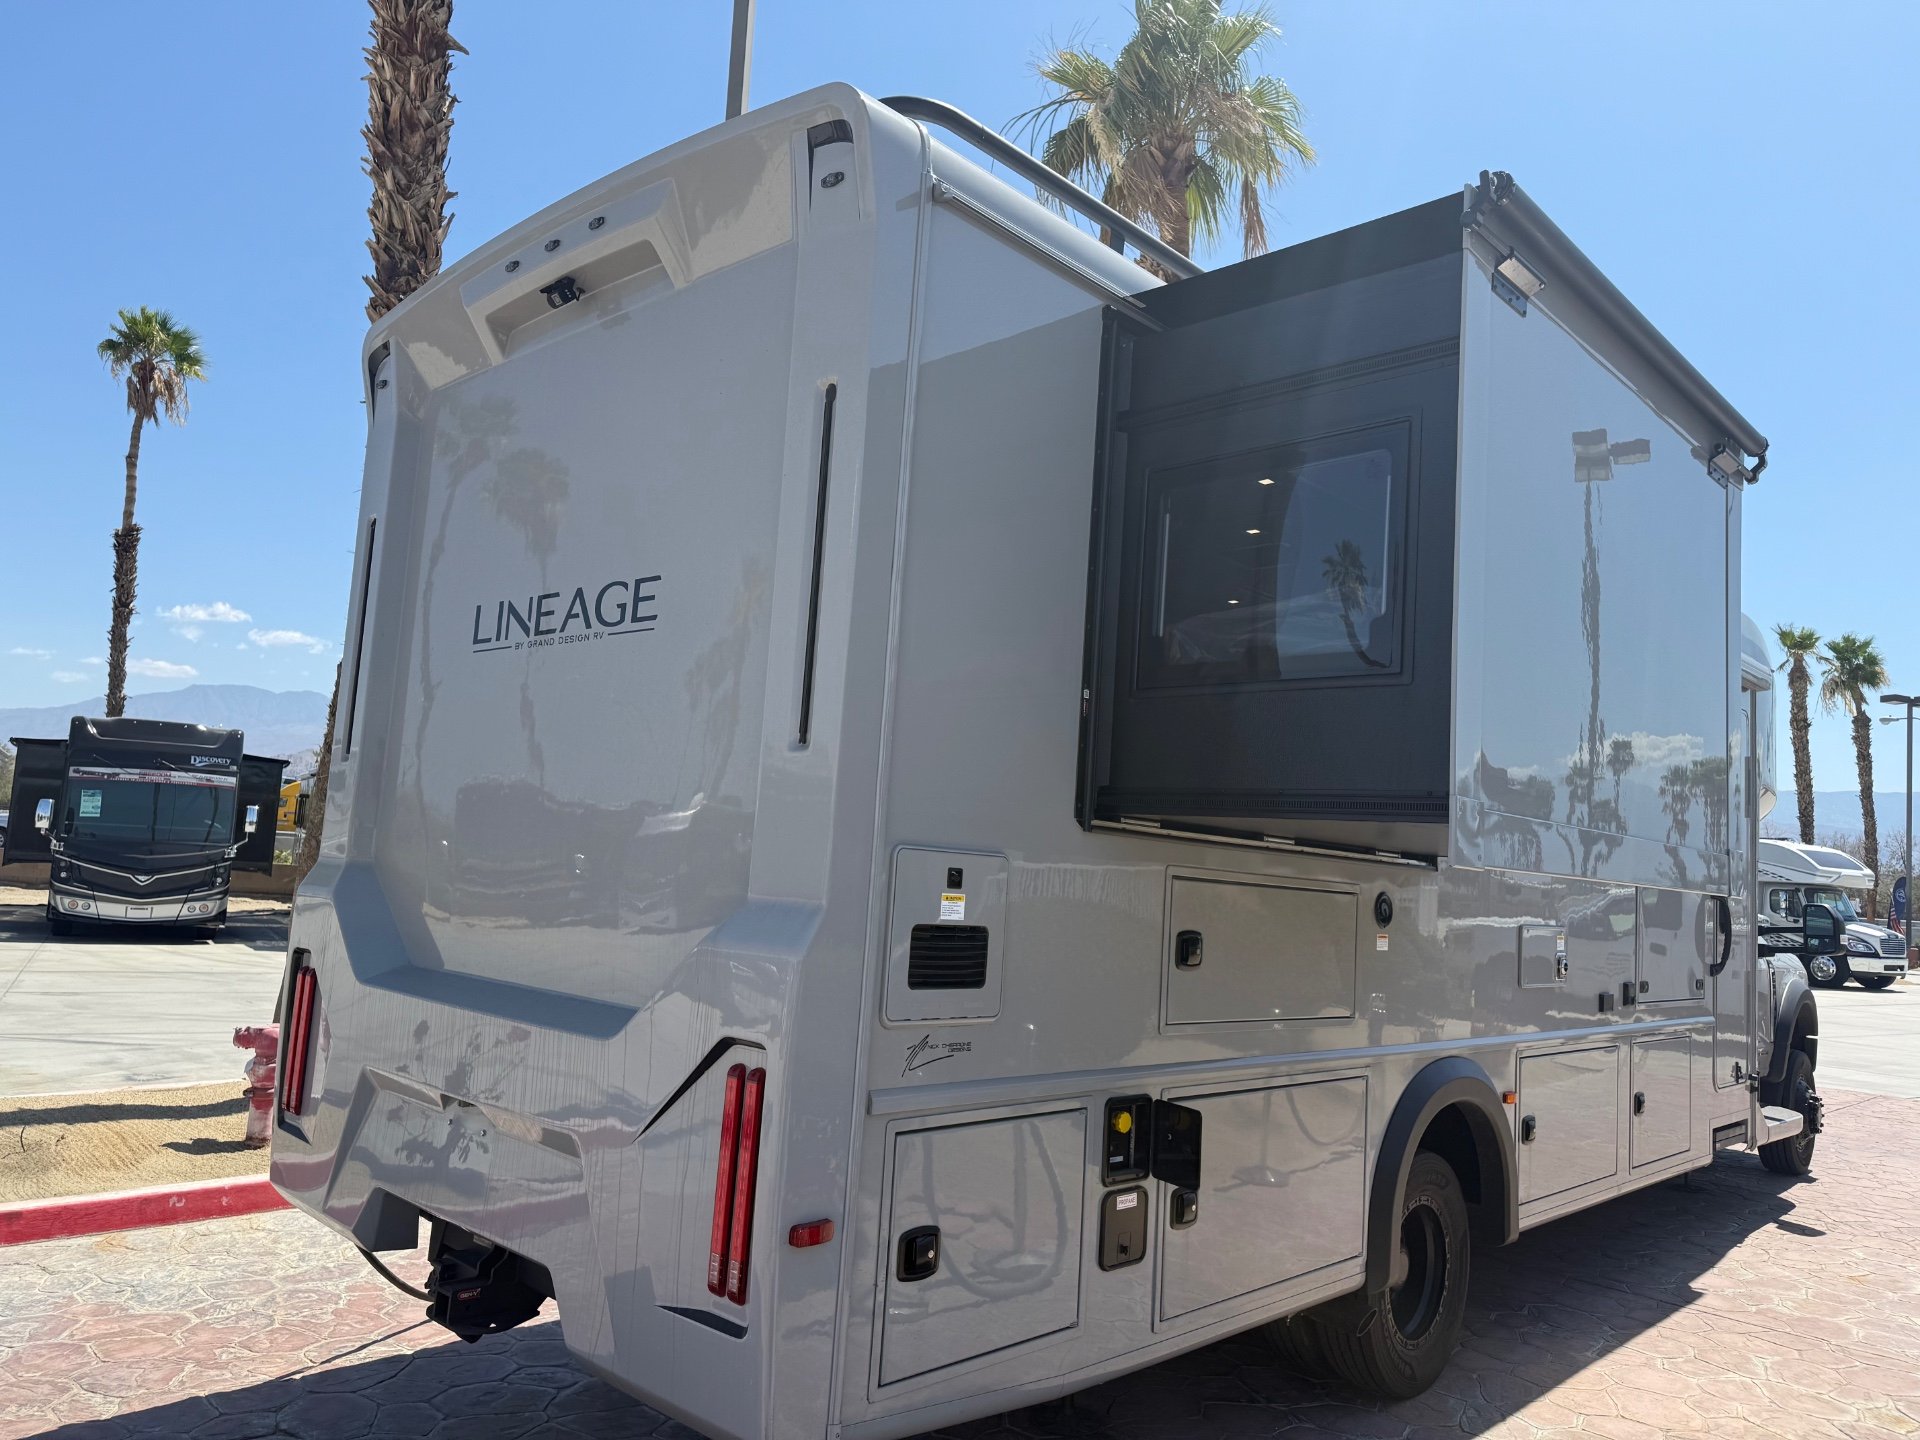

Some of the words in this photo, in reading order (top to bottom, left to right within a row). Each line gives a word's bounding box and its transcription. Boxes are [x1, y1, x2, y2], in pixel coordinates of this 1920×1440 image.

[473, 575, 662, 645] LINEAGE
[514, 642, 524, 650] BY
[527, 637, 555, 649] GRAND
[558, 632, 590, 645] DESIGN
[593, 631, 605, 640] RV
[1118, 1196, 1136, 1206] PROPANE
